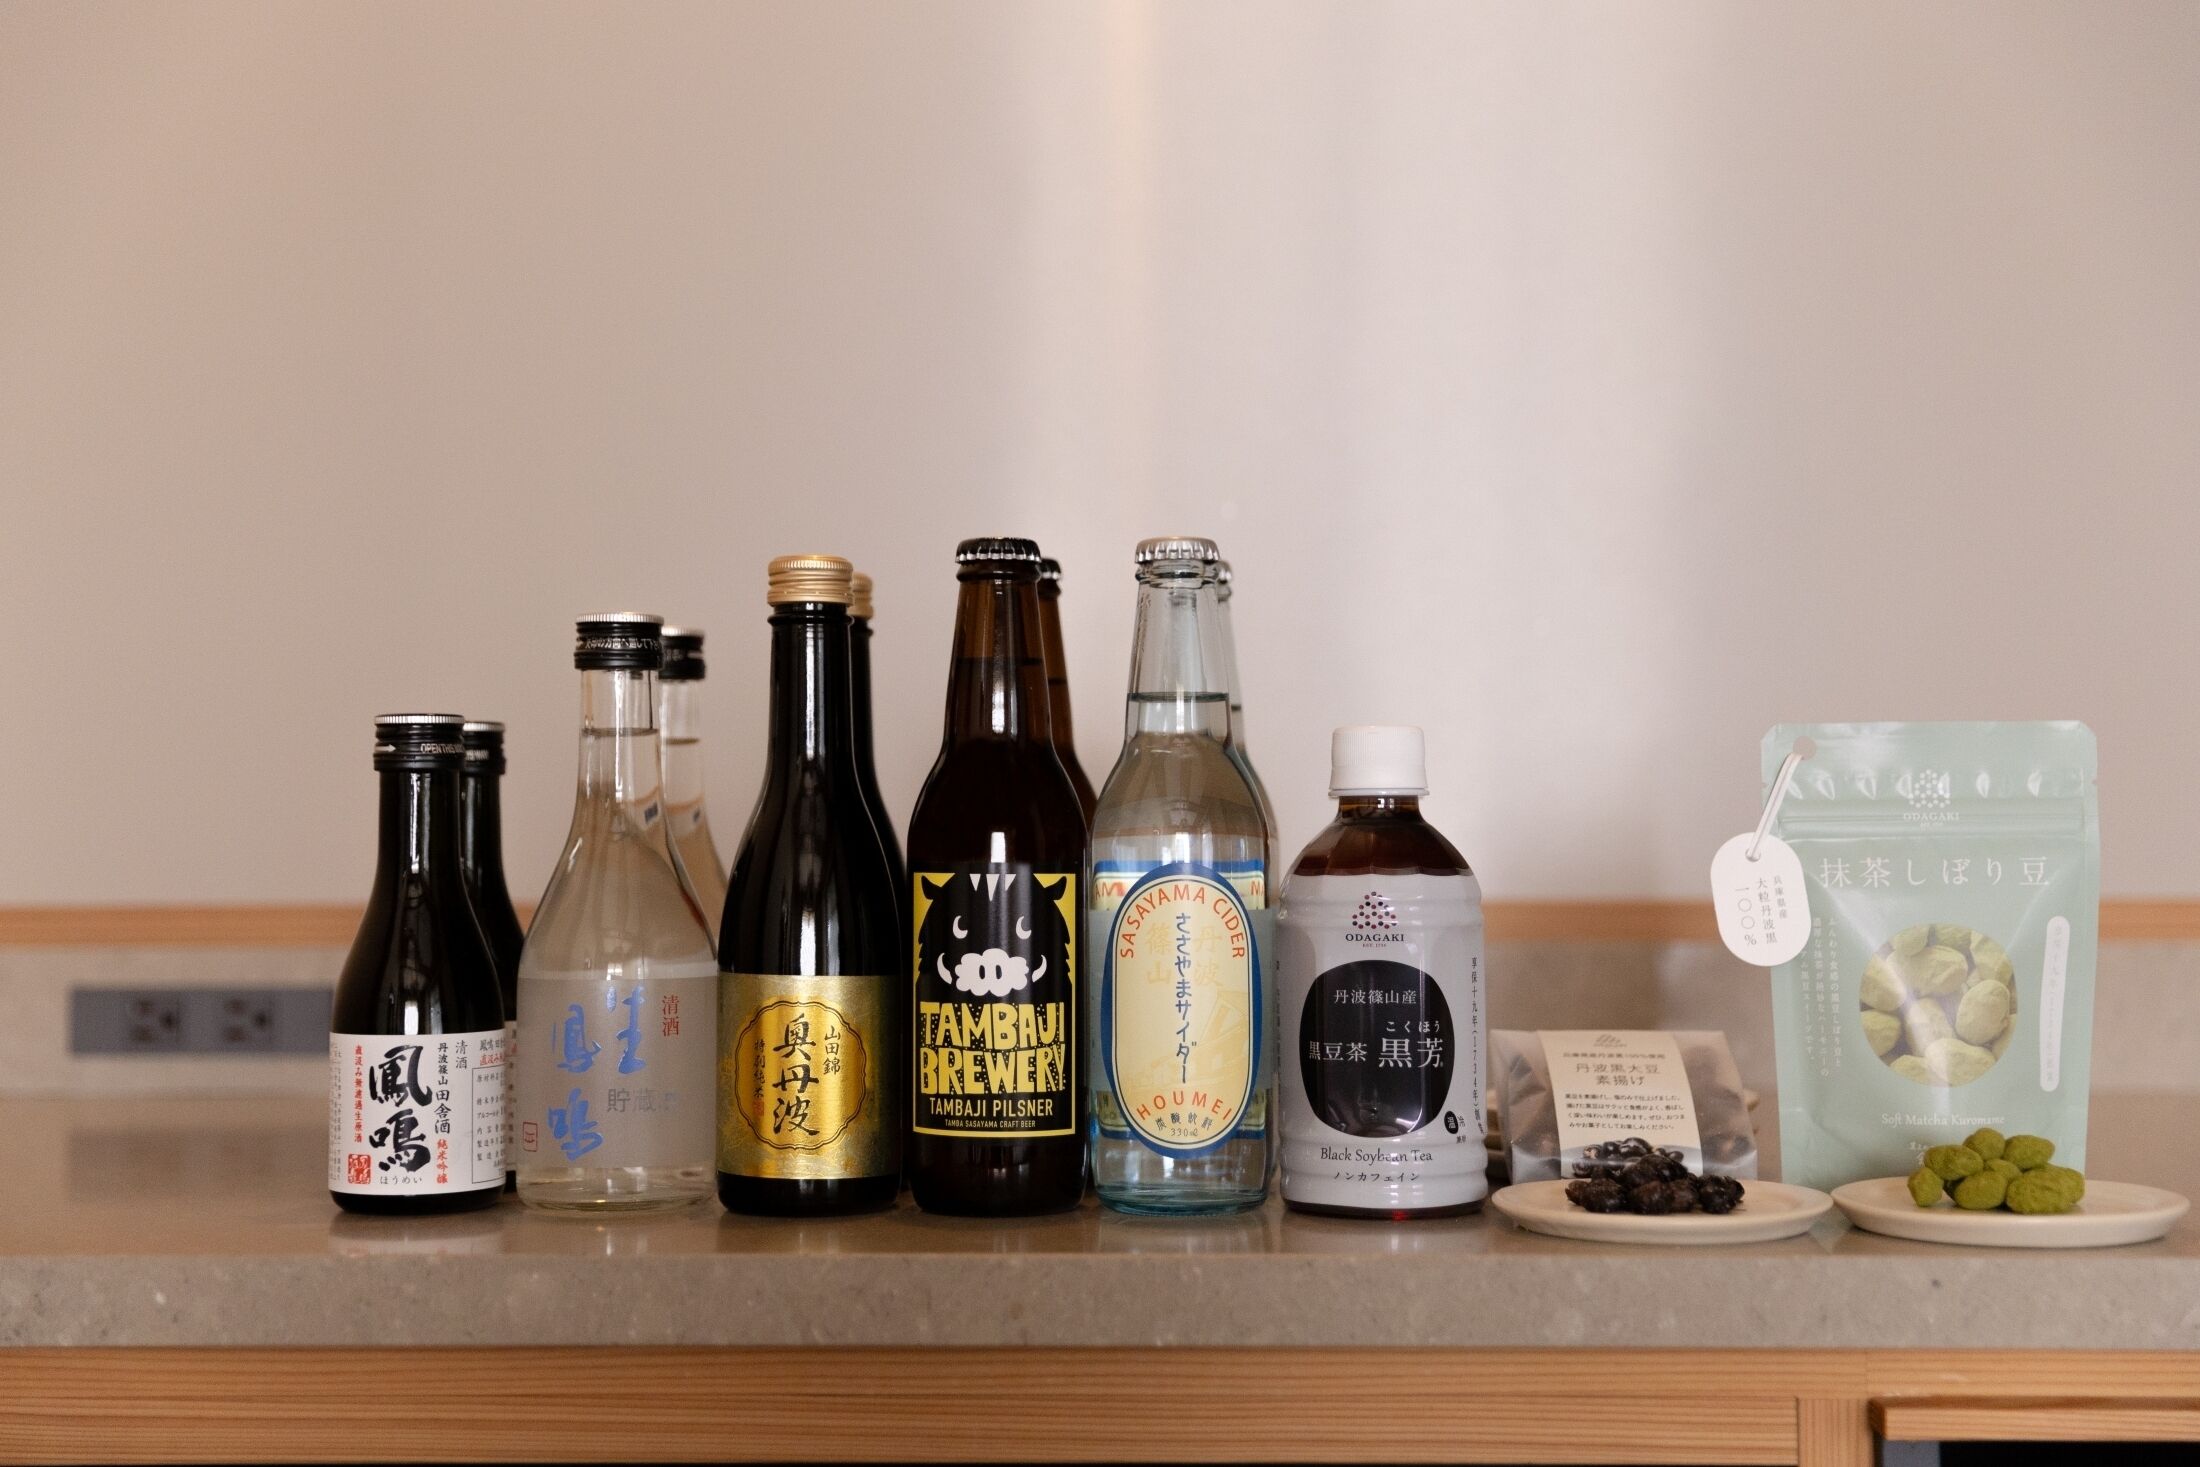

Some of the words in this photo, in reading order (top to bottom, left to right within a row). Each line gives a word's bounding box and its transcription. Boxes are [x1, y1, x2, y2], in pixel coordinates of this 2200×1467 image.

[420, 743, 441, 753] OPEN
[1903, 812, 1960, 822] ODAGAKI
[1820, 857, 2050, 889] 抹茶しぼり豆
[1120, 884, 1206, 959] SASAYAMA
[1212, 898, 1245, 958] CIDER
[1345, 933, 1404, 942] ODAGAKI
[1174, 912, 1197, 1084] ささやまサイダー
[1333, 989, 1418, 1005] 丹波篠山産
[662, 995, 680, 1037] 清酒
[920, 1002, 1065, 1050] TAMBAJI
[1386, 1021, 1441, 1032] こくほう
[455, 1039, 468, 1069] 清酒
[822, 1025, 841, 1075] 山田錦
[1309, 1041, 1368, 1062] 黒豆茶
[1378, 1037, 1443, 1068] 黒芳
[773, 1012, 820, 1136] 奥丹波
[920, 1044, 1066, 1095] BREWERY
[1576, 1063, 1661, 1075] 丹波黒大豆
[1596, 1074, 1646, 1087] 素揚げ
[434, 1042, 452, 1134] 丹波篠山田舎酒
[607, 1088, 675, 1113] 貯蔵
[369, 1045, 433, 1173] 鳳鳴
[930, 1097, 986, 1117] TAMBAJI
[993, 1097, 1053, 1117] PILSNER
[1137, 1090, 1233, 1121] HOUMEI
[945, 1118, 964, 1127] TAMBA
[965, 1119, 998, 1128] SASAYAMA
[999, 1120, 1019, 1128] CRAFT
[1020, 1119, 1036, 1128] BEER
[1881, 1112, 1903, 1128] Soft
[1905, 1112, 1948, 1126] Matcha
[1951, 1113, 2006, 1126] Kuromame
[436, 1138, 449, 1184] 純米吟醸
[1321, 1147, 1352, 1161] Black
[1355, 1149, 1408, 1166] Soybean
[1412, 1149, 1433, 1162] Tea
[380, 1177, 422, 1185] ほうめい
[1333, 1171, 1420, 1182] ノンカフェイン
